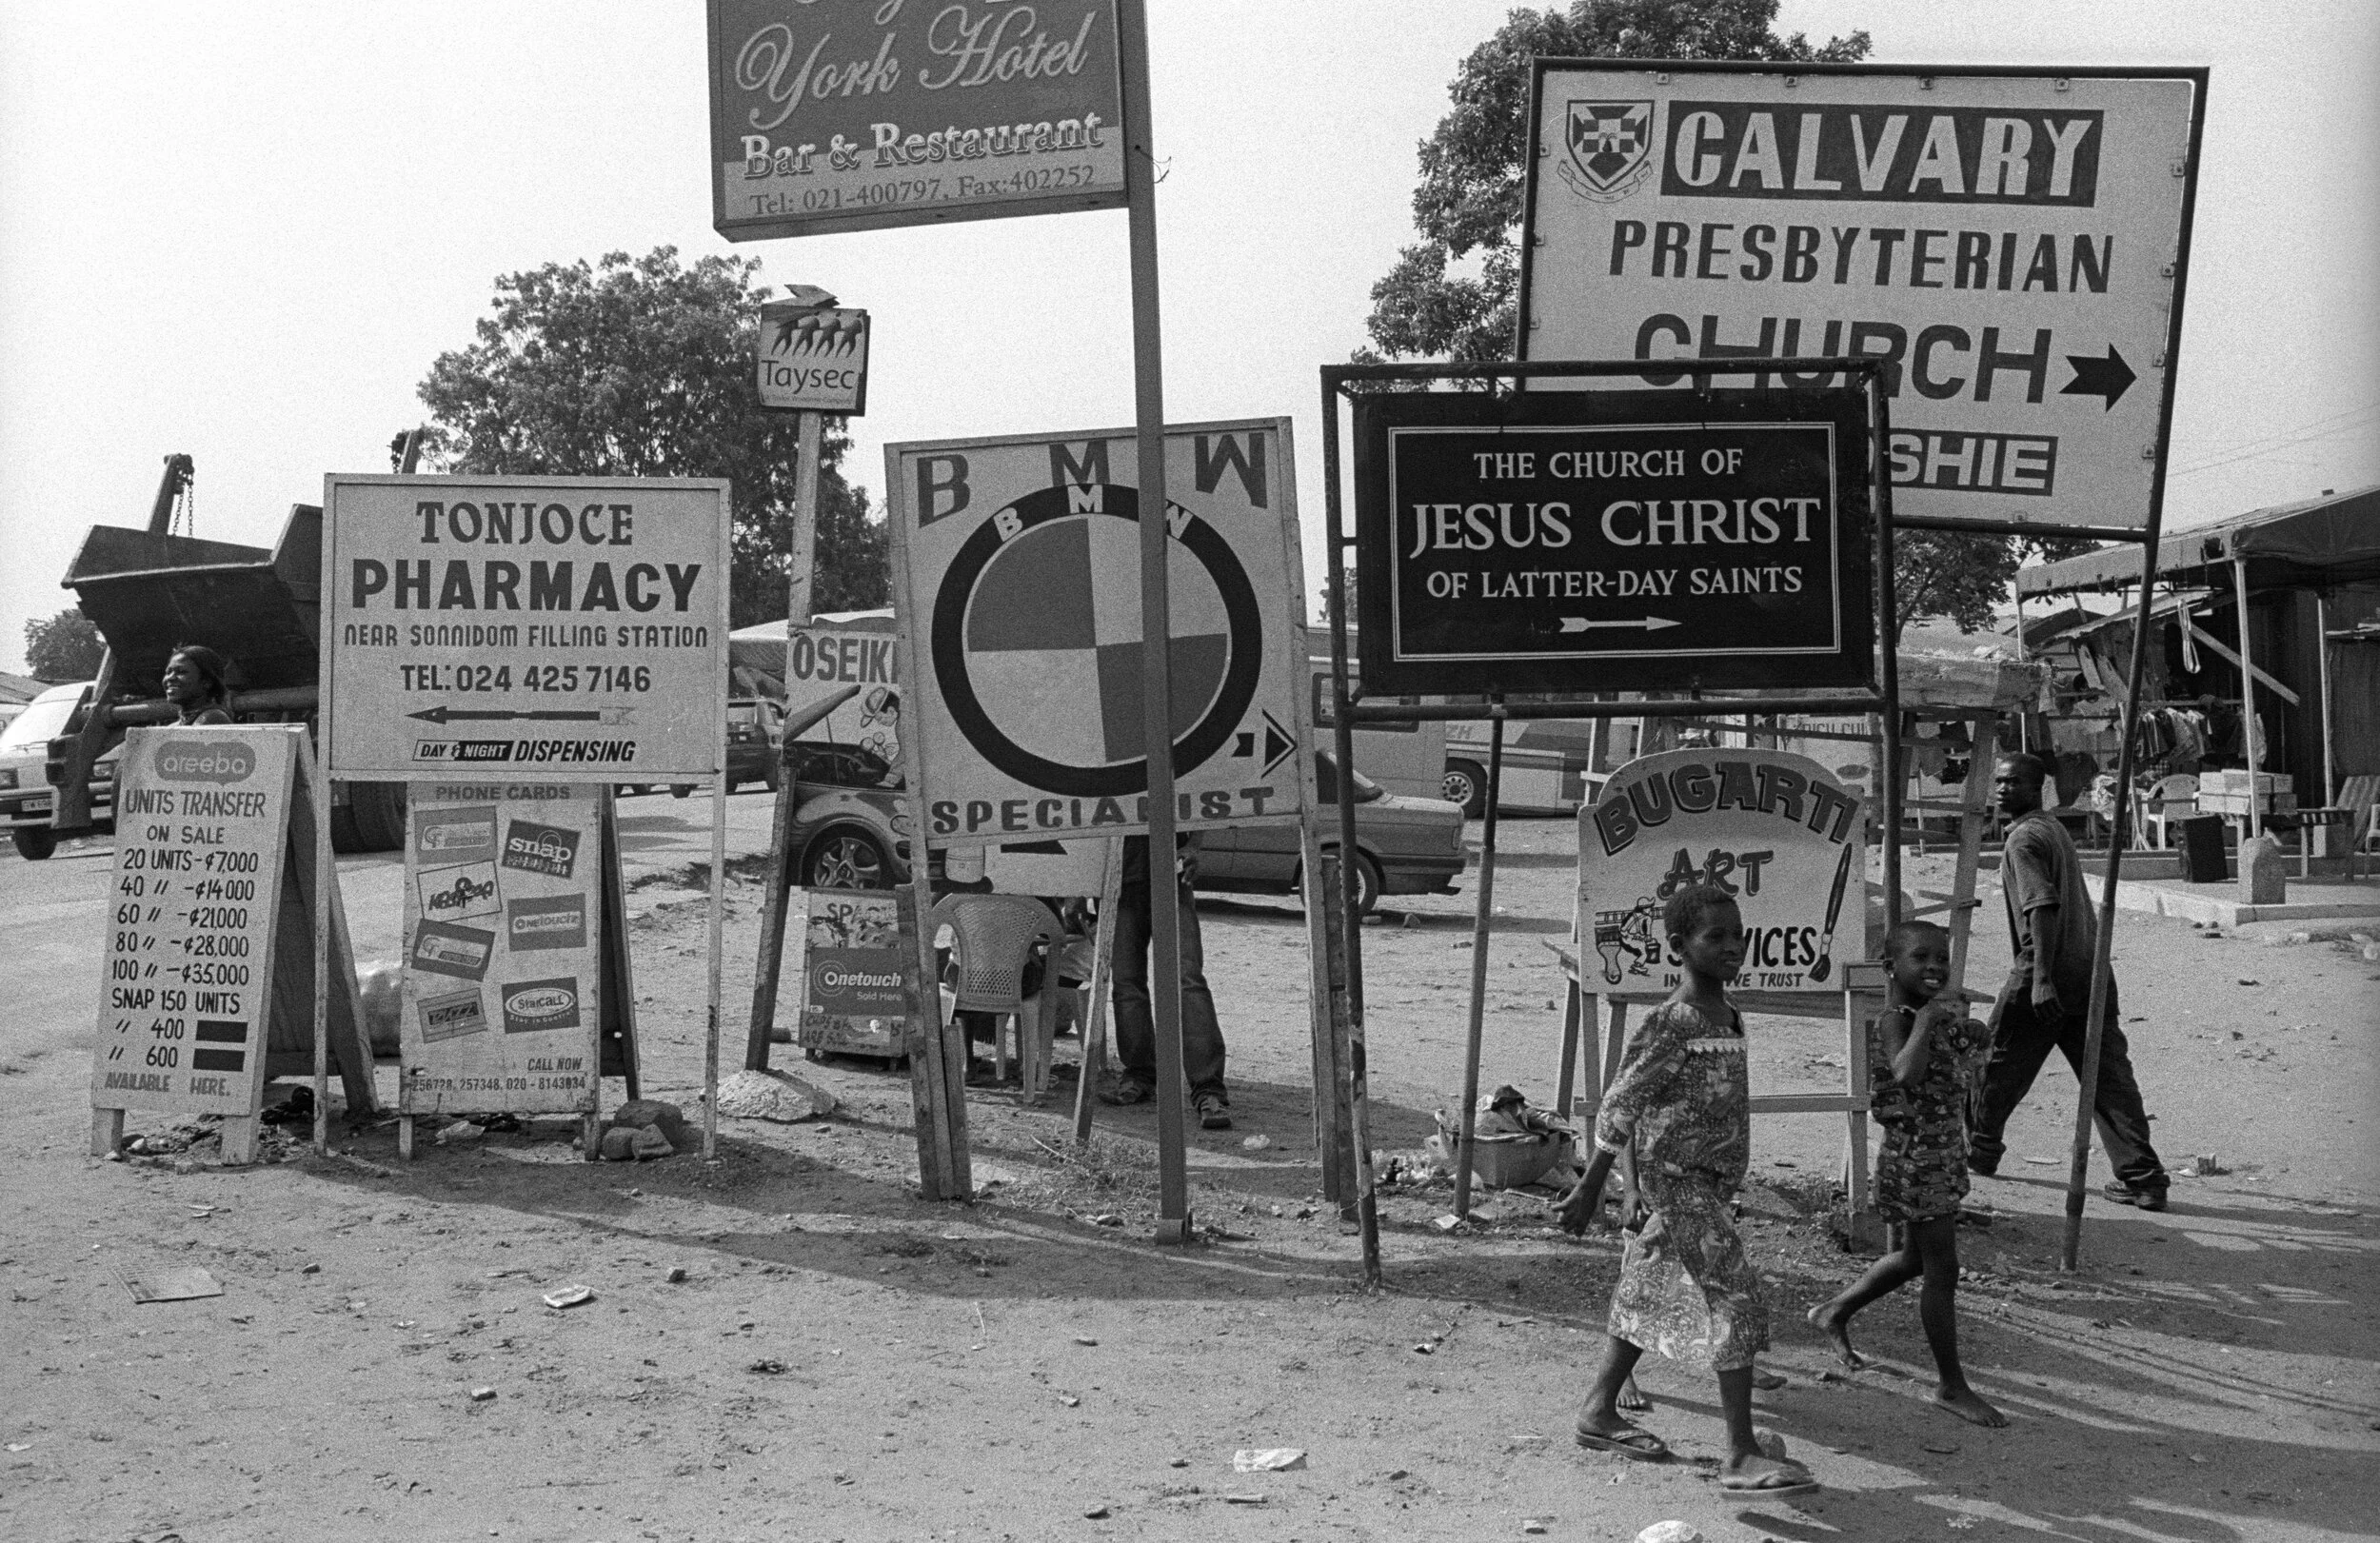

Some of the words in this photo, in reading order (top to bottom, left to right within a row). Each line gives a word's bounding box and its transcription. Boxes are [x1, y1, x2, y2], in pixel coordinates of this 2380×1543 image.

[735, 23, 901, 131] York
[920, 5, 1096, 90] Hotel
[741, 134, 816, 180] Bar
[829, 132, 861, 172] &
[869, 111, 1104, 168] Restaurant
[1674, 109, 2094, 199] CALVARY
[749, 192, 795, 216] Tel:
[1609, 218, 2114, 294] PRESBYTERIAN
[1634, 312, 2053, 405] CHURCH
[761, 359, 855, 395] Taysec
[1473, 450, 1536, 480] THE
[1548, 448, 1686, 479] CHURCH
[1700, 447, 1743, 475] OF
[1869, 433, 2050, 490] SHIE
[415, 501, 634, 546] TONJOCE
[1409, 502, 1572, 560] JESUS
[1600, 496, 1821, 547] CHRIST
[351, 558, 703, 613] PHARMACY
[1427, 570, 1469, 599] OF
[1481, 568, 1680, 599] LATTER-DAY
[1690, 565, 1802, 595] SAINTS
[455, 665, 512, 693] 024
[163, 751, 247, 775] areeba
[420, 743, 447, 758] DAY
[450, 742, 461, 758] &
[464, 743, 507, 759] NIGHT
[514, 740, 637, 762] DISPENSING
[125, 789, 174, 815] UNITS
[180, 790, 267, 818] TRANSFER
[436, 785, 502, 801] PHONE
[506, 785, 570, 801] CARDS
[1593, 761, 1859, 857] BUGARTI
[146, 824, 169, 843] ON
[180, 825, 226, 845] SALE
[123, 848, 146, 870] 20
[508, 837, 572, 863] snap
[120, 875, 144, 897] 40
[1656, 847, 1775, 900] ART
[117, 903, 140, 925] 60
[115, 931, 138, 953] 80
[112, 959, 139, 981] 100
[823, 971, 902, 987] Onetouch
[1663, 973, 1681, 988] IN
[1758, 972, 1805, 988] TRUST
[111, 987, 155, 1010] SNAP
[160, 989, 187, 1012] 150
[194, 991, 241, 1015] UNITS
[150, 1018, 185, 1040] 400
[146, 1045, 178, 1068] 600
[527, 1058, 554, 1072] CALL
[556, 1057, 584, 1071] NOW
[104, 1071, 171, 1093] AVAILABLE
